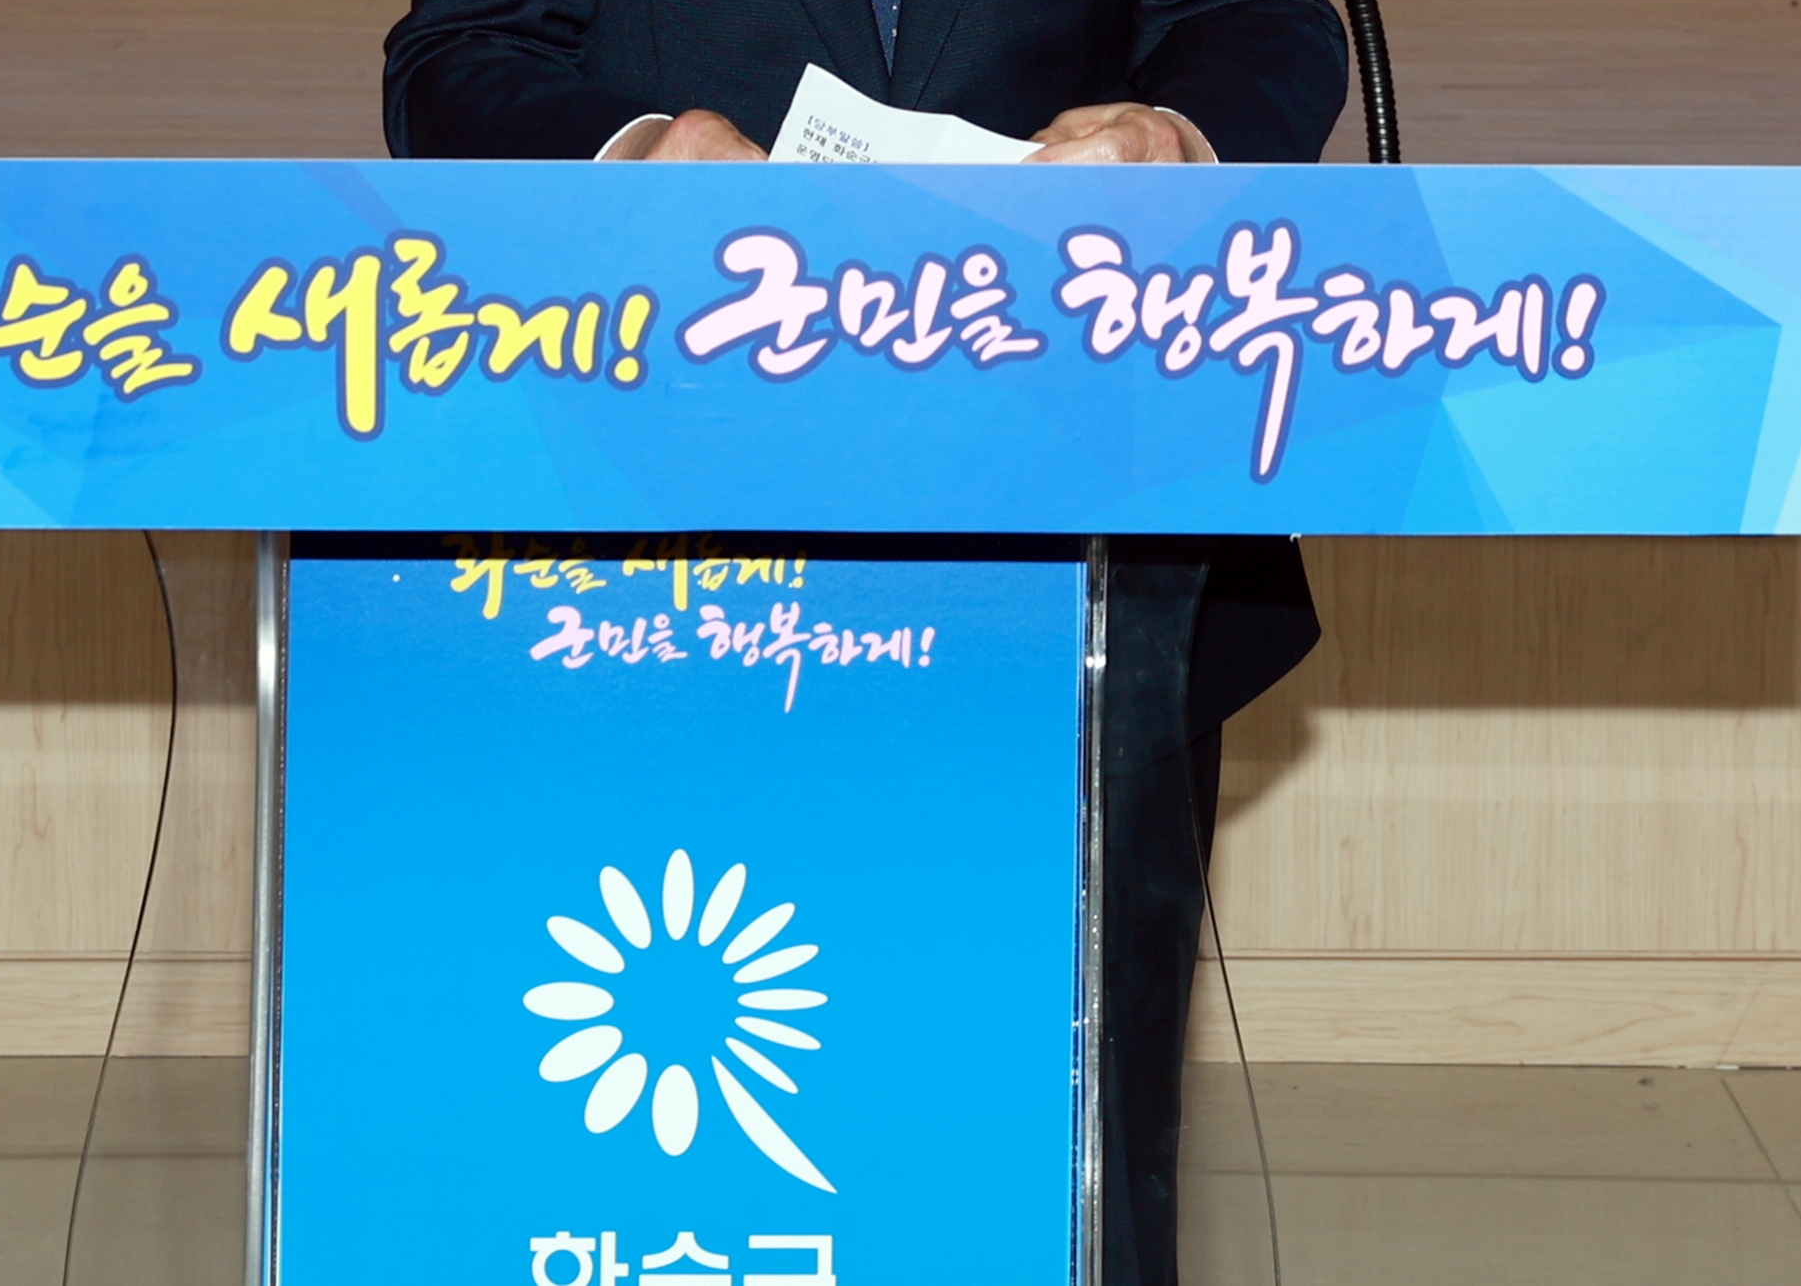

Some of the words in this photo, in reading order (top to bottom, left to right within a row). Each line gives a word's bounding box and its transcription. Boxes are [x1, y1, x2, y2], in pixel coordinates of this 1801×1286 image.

[228, 238, 652, 435] 새롭게!
[683, 233, 1040, 377] 군민을
[1060, 226, 1599, 477] 행복하게!
[529, 604, 689, 670] 군민을
[696, 601, 936, 714] 행복하게!
